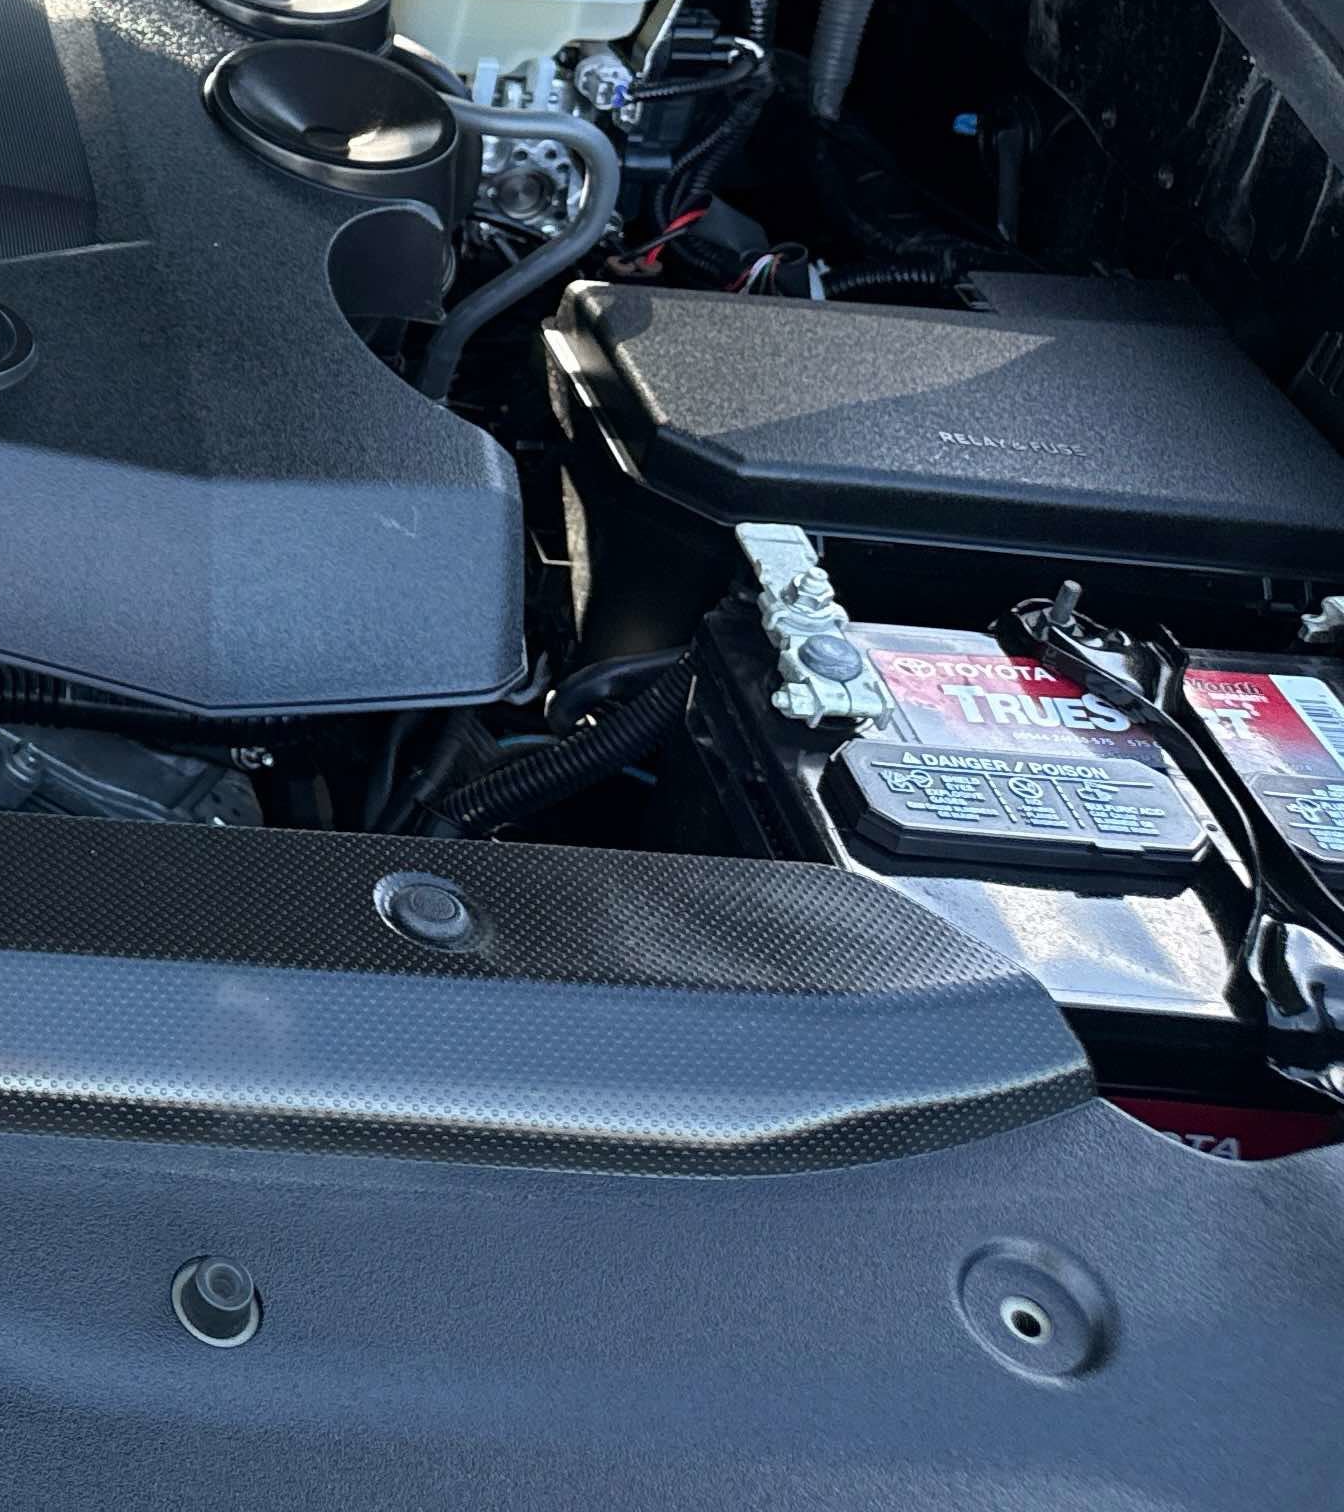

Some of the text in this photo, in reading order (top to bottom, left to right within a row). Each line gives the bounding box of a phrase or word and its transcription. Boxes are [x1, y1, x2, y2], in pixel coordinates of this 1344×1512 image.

[938, 431, 1006, 448] RELAY
[1028, 442, 1087, 456] FUSE
[937, 662, 1056, 682] TOYOTA
[921, 753, 1010, 772] DANGER
[1028, 762, 1110, 780] POISON
